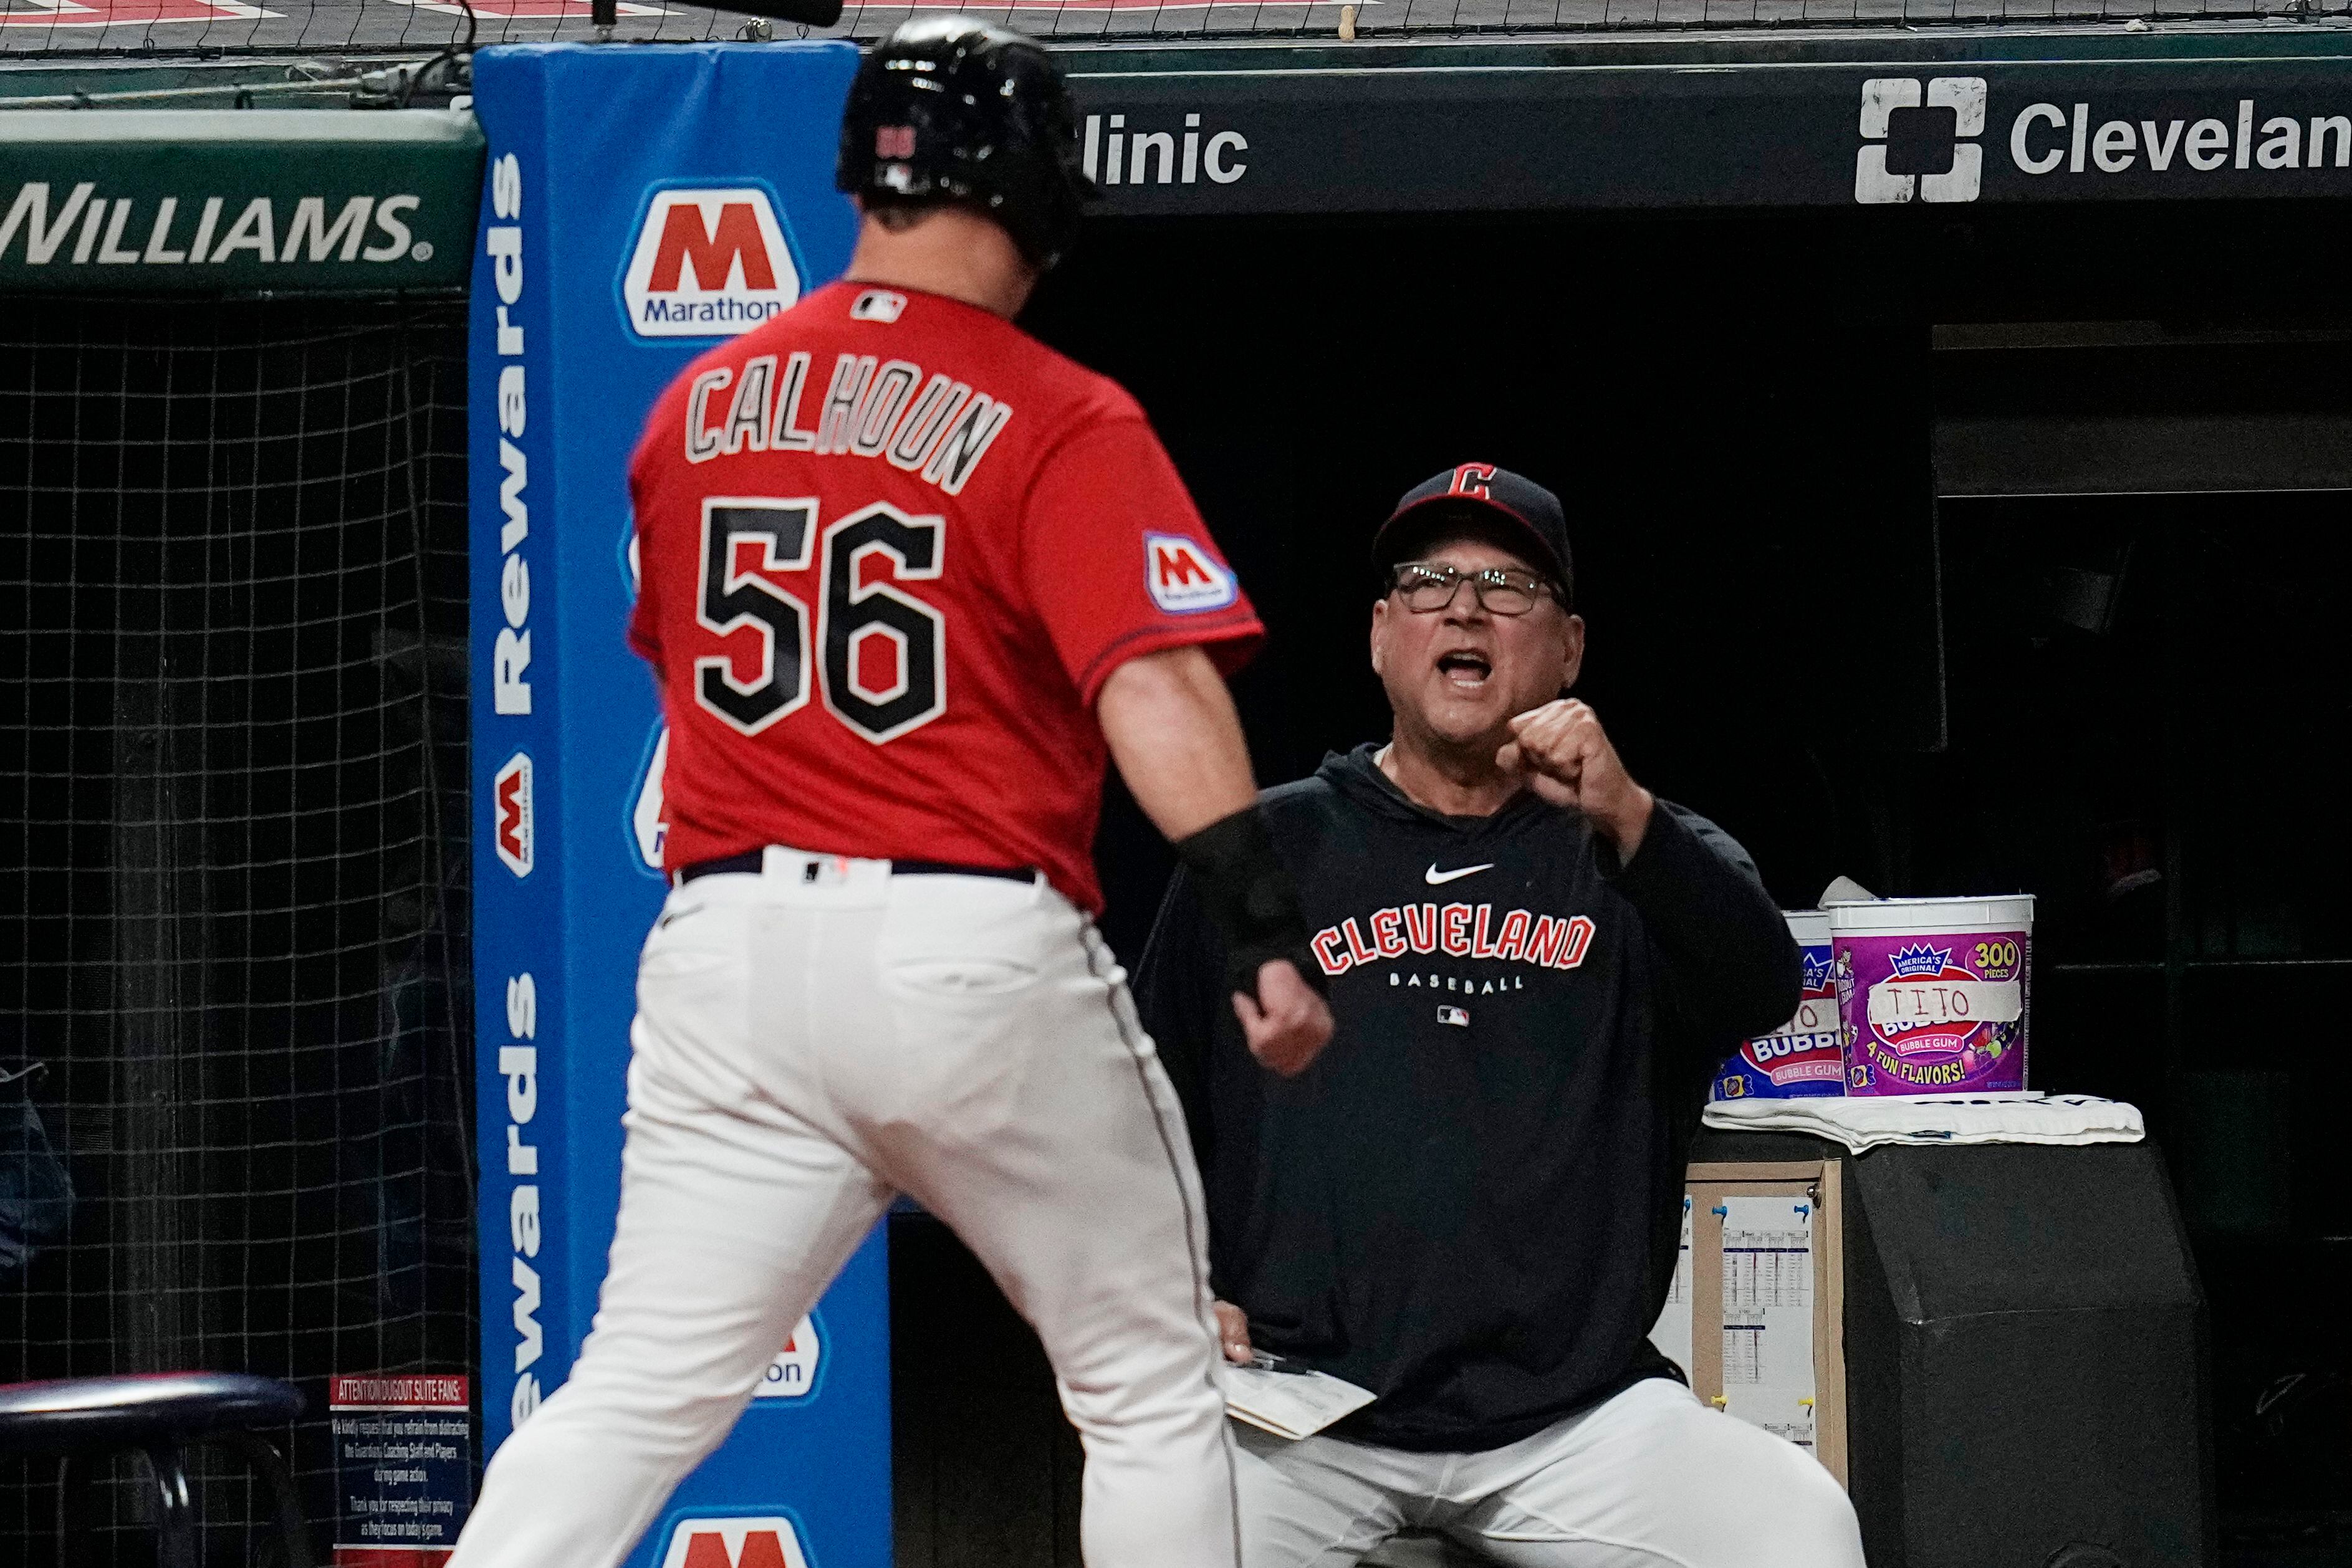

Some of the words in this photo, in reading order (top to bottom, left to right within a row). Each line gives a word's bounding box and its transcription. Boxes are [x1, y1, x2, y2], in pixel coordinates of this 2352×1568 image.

[648, 203, 777, 293] M
[645, 297, 781, 322] Marathon
[487, 152, 532, 715] Rewards
[685, 351, 1013, 496] CALHOUN
[694, 496, 947, 745] 56
[1310, 902, 1596, 976] CLEVELAND
[1898, 956, 1942, 968] AMERICA'S
[1974, 942, 2015, 968] 300
[1901, 965, 1937, 973] ORIGINAL
[1984, 968, 2009, 978] PIECES
[1390, 972, 1524, 995] BASEBALL
[1887, 988, 1969, 1017] TITO
[1900, 1039, 1931, 1051] BUBBLE
[1932, 1038, 1957, 1048] GUM
[1775, 1066, 1811, 1081] BUBBLE
[1814, 1064, 1841, 1076] GUM
[1866, 1041, 1878, 1058] 4
[1876, 1050, 1899, 1075] FUN
[1901, 1059, 1966, 1085] FLAVORS!
